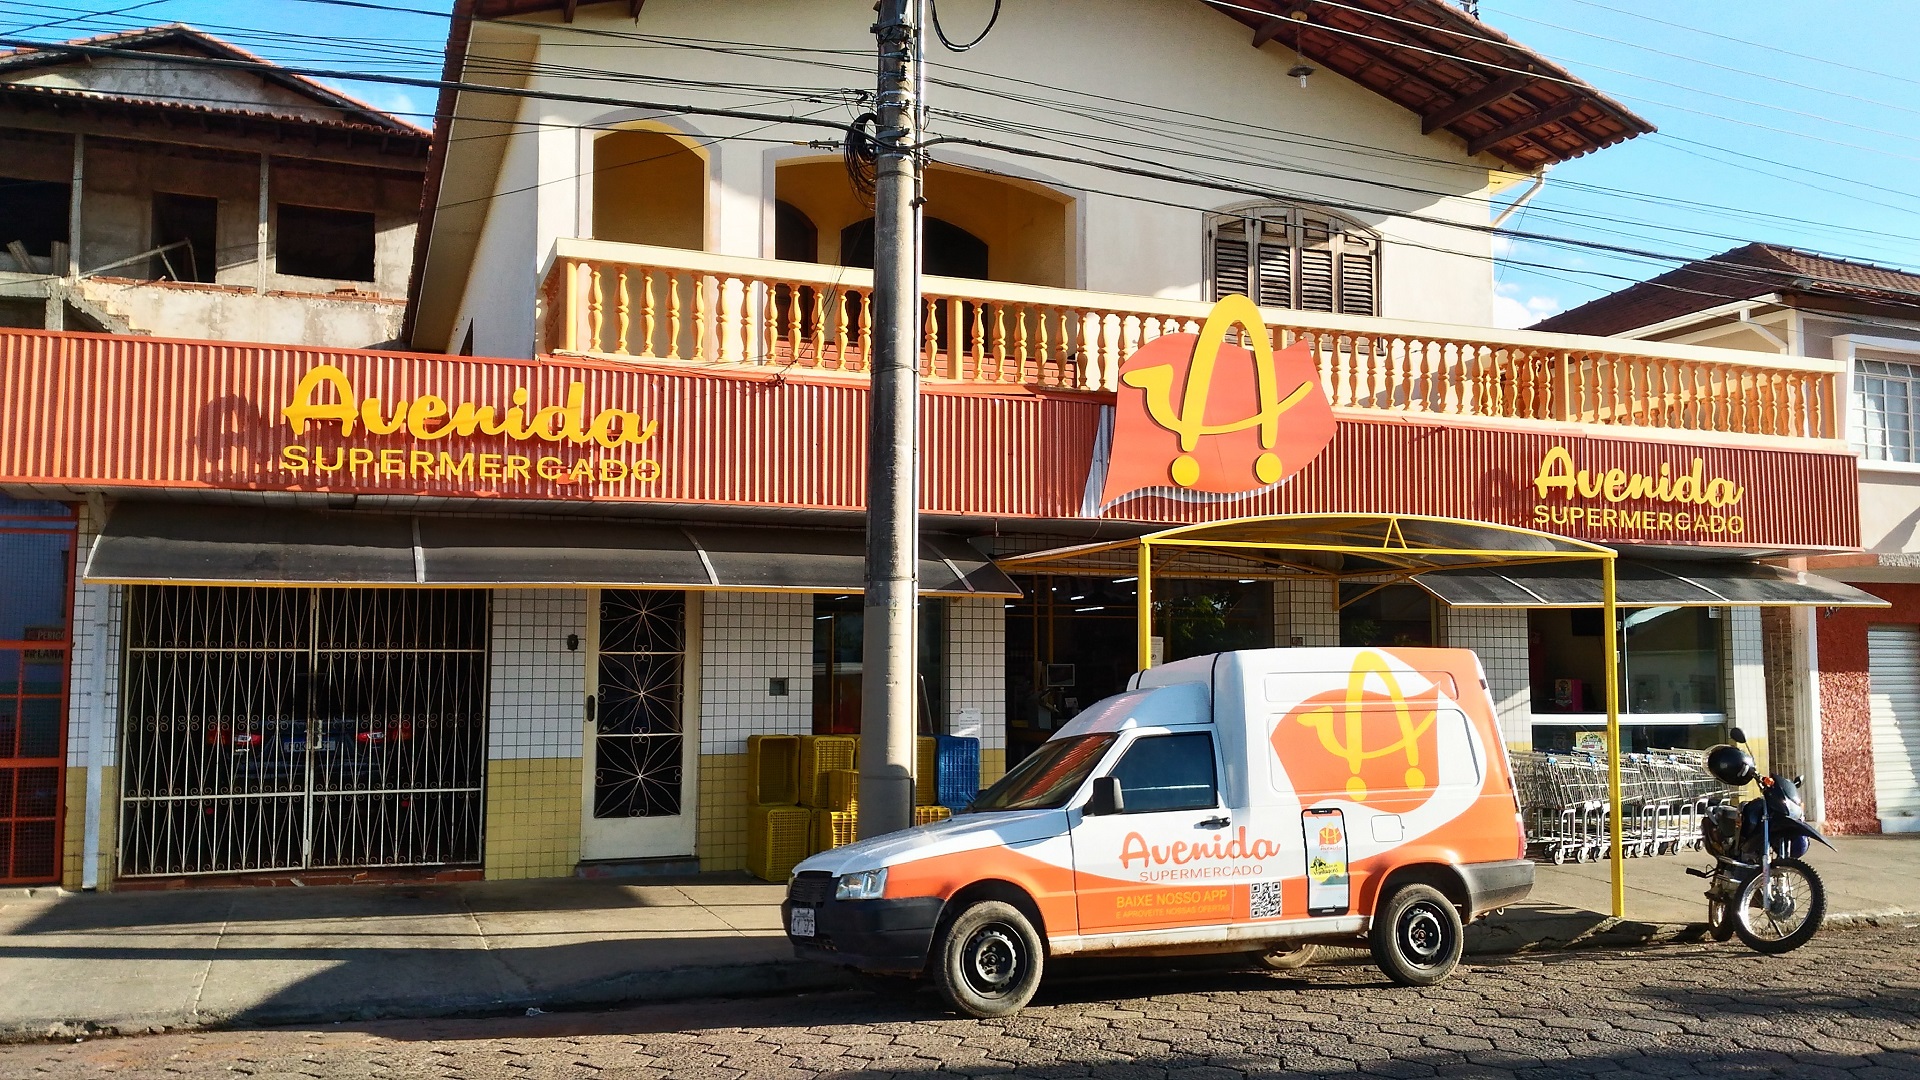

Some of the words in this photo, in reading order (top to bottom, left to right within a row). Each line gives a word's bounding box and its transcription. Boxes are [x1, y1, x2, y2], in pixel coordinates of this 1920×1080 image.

[281, 364, 659, 449] Avenida
[281, 445, 662, 482] SUPERMERCADO
[1534, 446, 1745, 508] Avenida
[1534, 504, 1745, 534] SUPERMERCADO
[1118, 826, 1281, 869] Avenida
[1139, 864, 1263, 882] SUPERMERCADO
[1115, 911, 1121, 919] E
[1123, 908, 1164, 918] APROVEITE
[1166, 906, 1197, 916] NOSSAS
[1199, 903, 1231, 912] OFERTAS
[1116, 895, 1153, 908] BAIXE
[1156, 891, 1200, 905] NOSSO
[1203, 889, 1227, 902] APP
